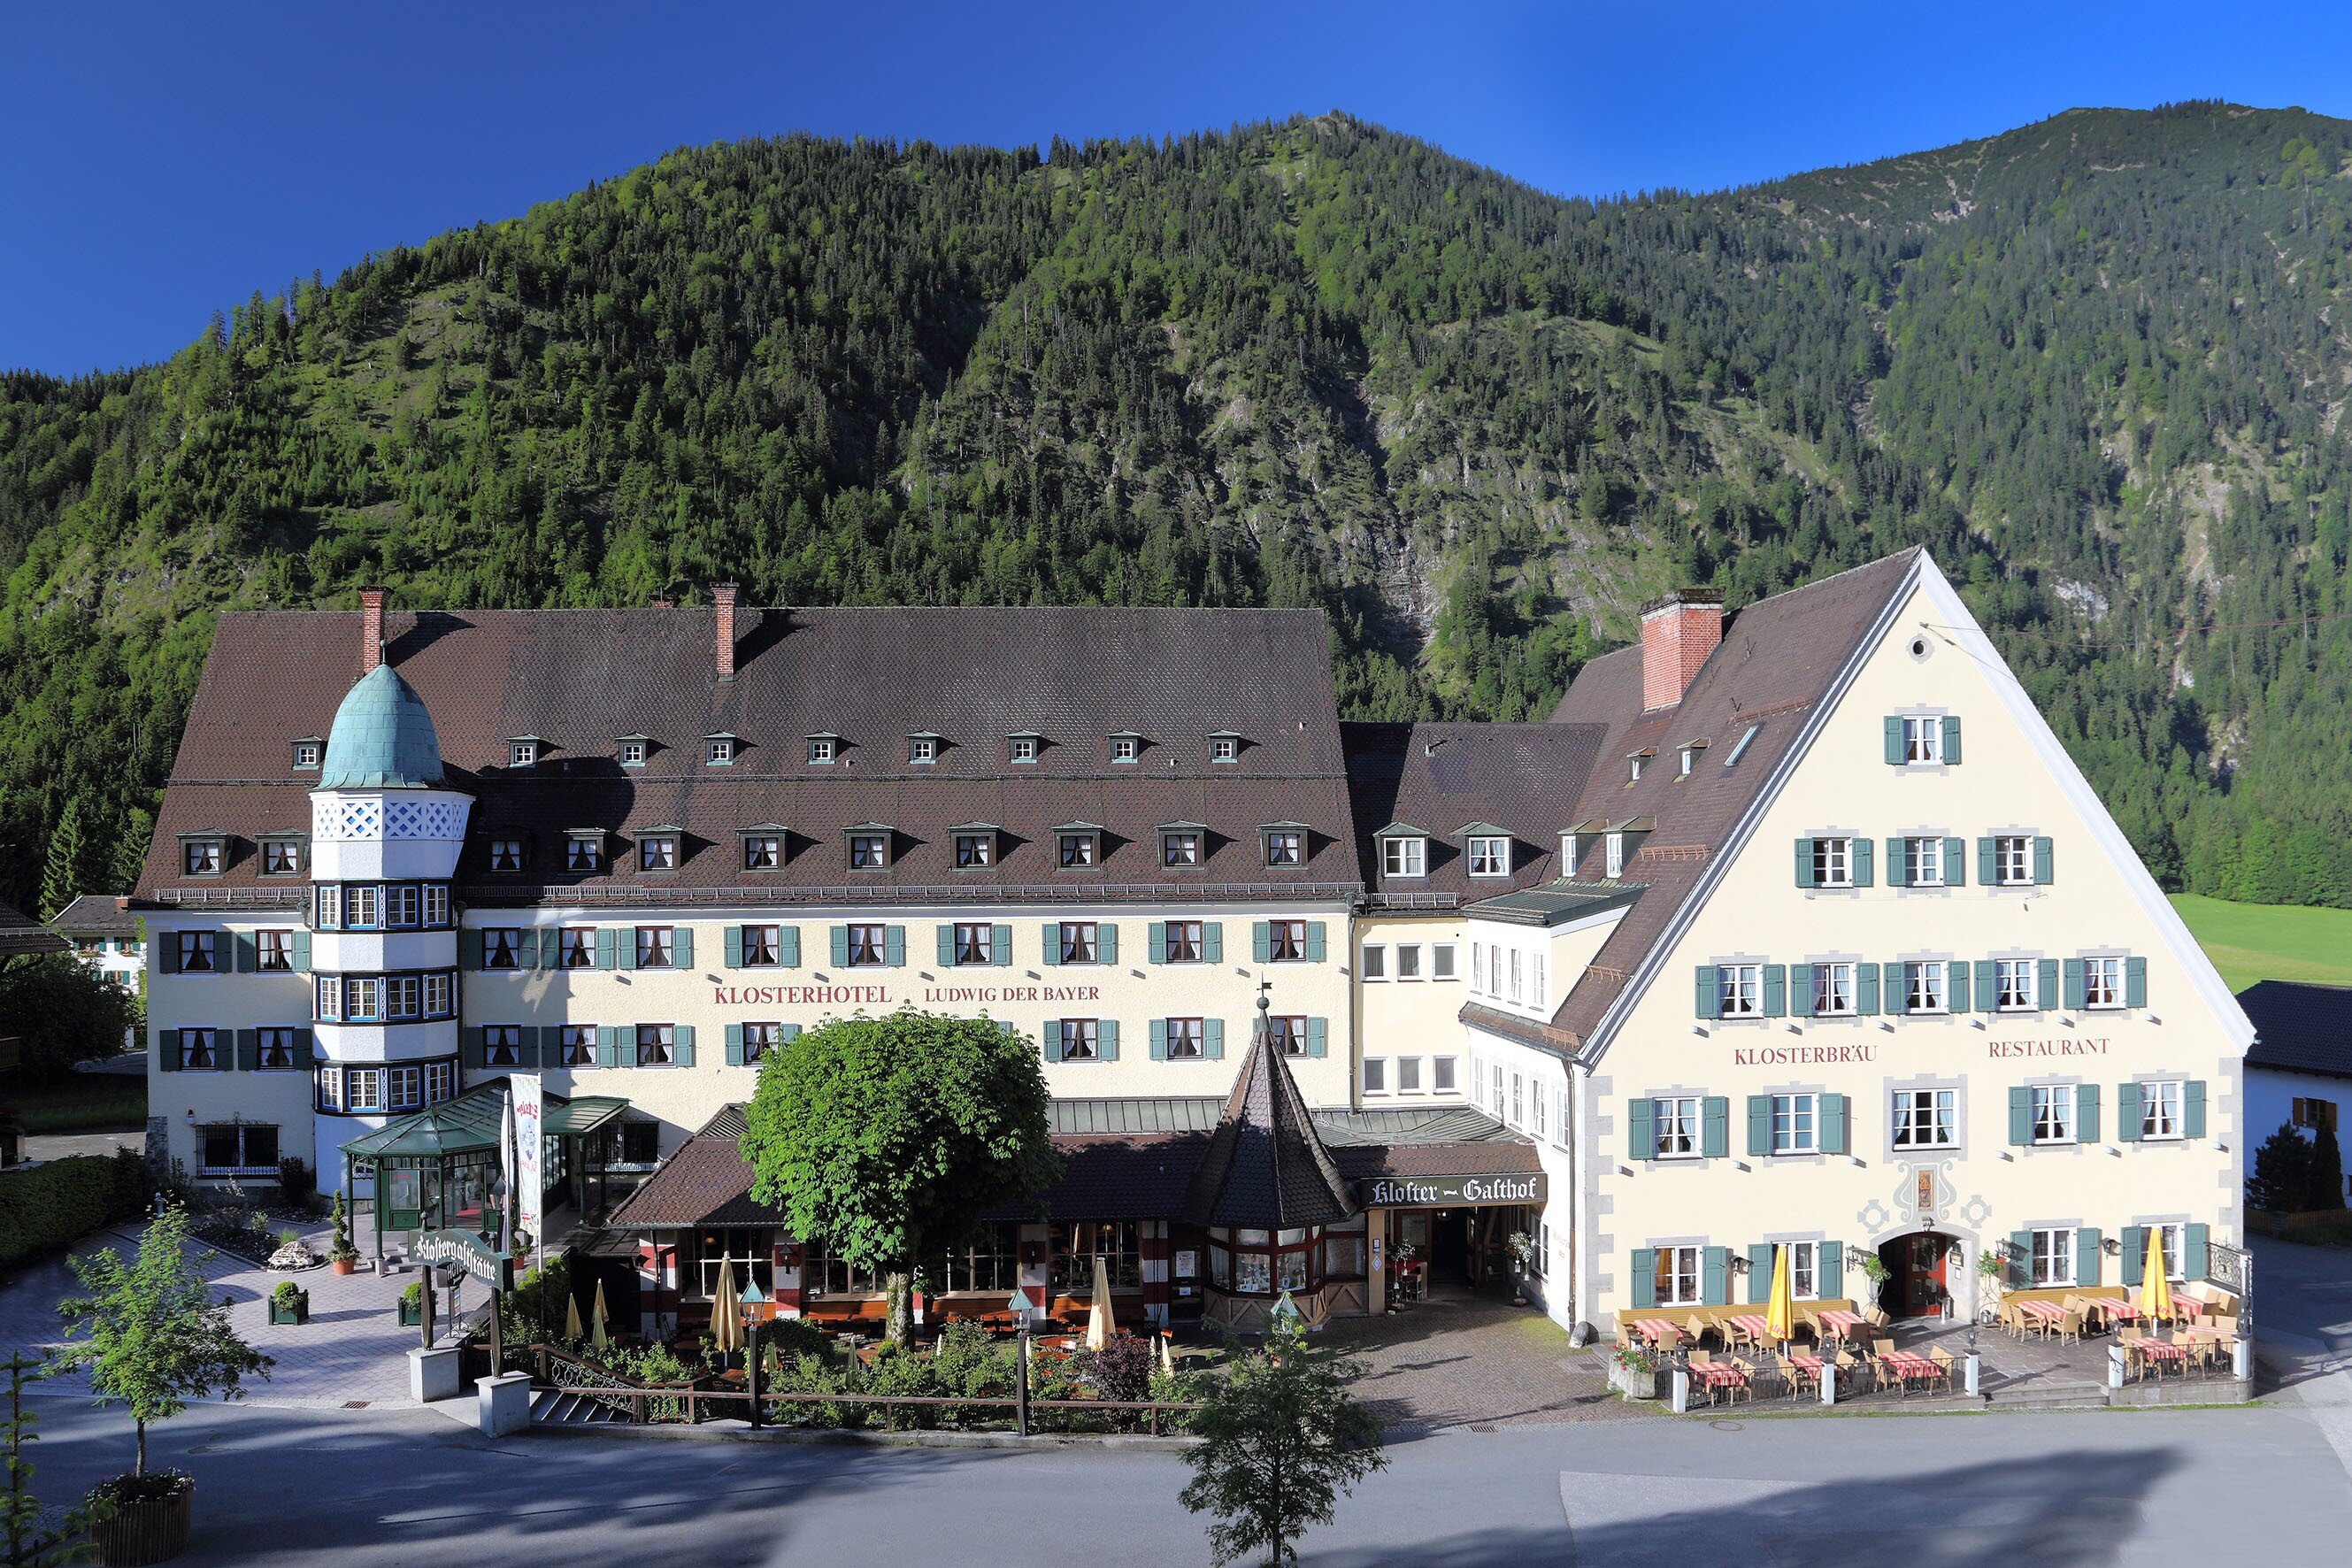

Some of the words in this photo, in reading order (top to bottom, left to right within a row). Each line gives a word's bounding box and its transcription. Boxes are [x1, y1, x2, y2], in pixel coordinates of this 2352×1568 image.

[714, 986, 892, 1004] KLOSTERHOTEL
[925, 988, 996, 1003] LUDWIG
[1003, 988, 1039, 1002] DER
[1043, 986, 1100, 1001] BAYER
[1734, 1044, 1879, 1065] KLOSTERBRÄU
[1988, 1038, 2110, 1058] RESTAURANT
[1463, 1177, 1537, 1201] Gasthof
